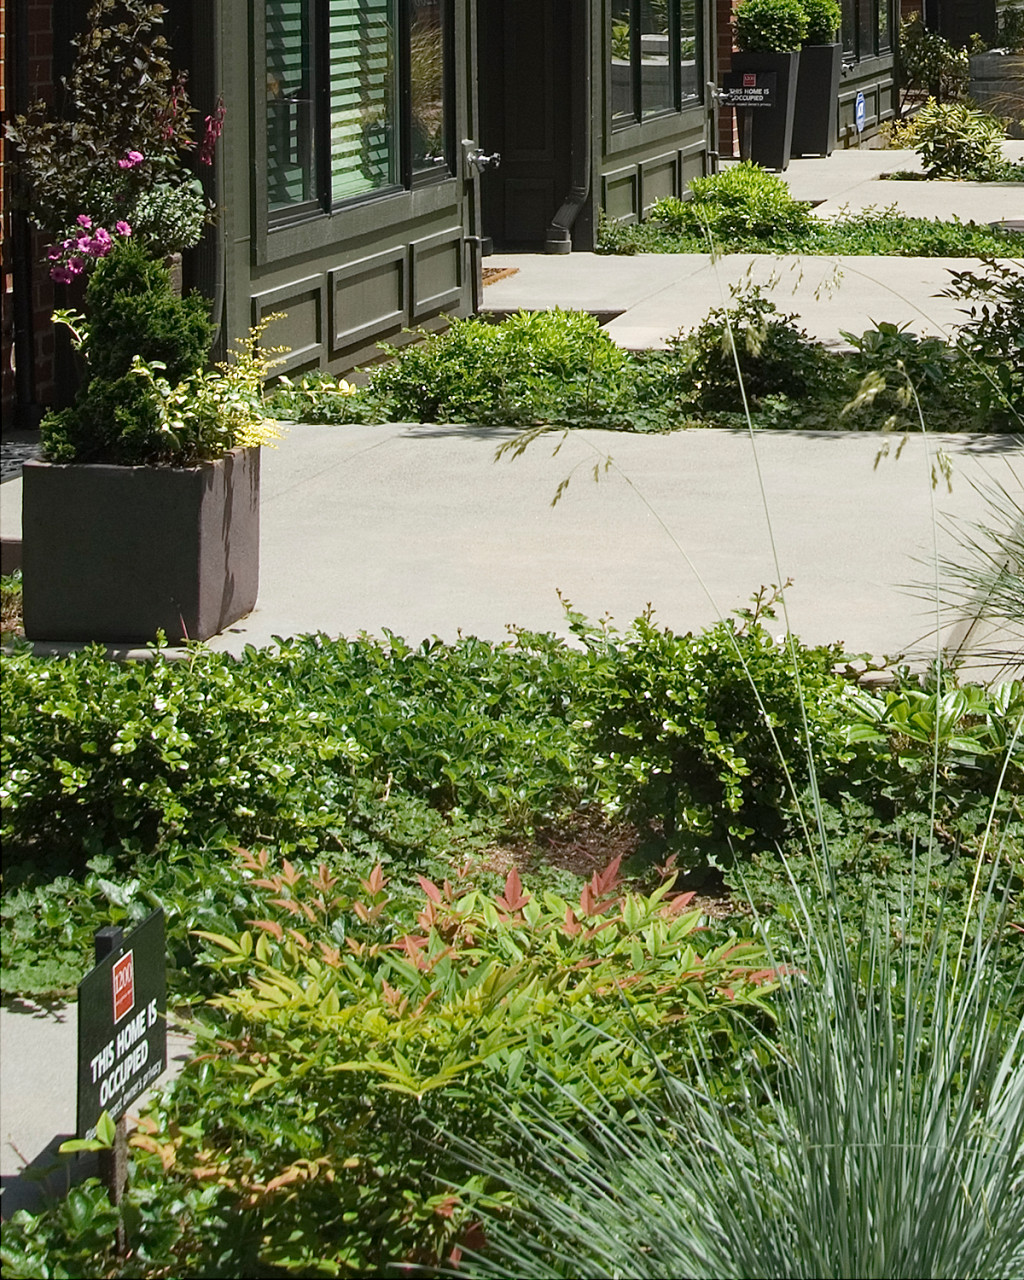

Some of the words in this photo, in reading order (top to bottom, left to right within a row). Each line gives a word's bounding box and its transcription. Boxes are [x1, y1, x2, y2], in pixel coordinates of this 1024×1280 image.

[115, 962, 133, 994] 1200
[91, 1039, 115, 1083] THIS
[116, 1008, 146, 1059] HOME
[147, 997, 157, 1028] IS
[100, 1039, 149, 1107] OCCUPIED
[142, 1058, 162, 1089] privacy
